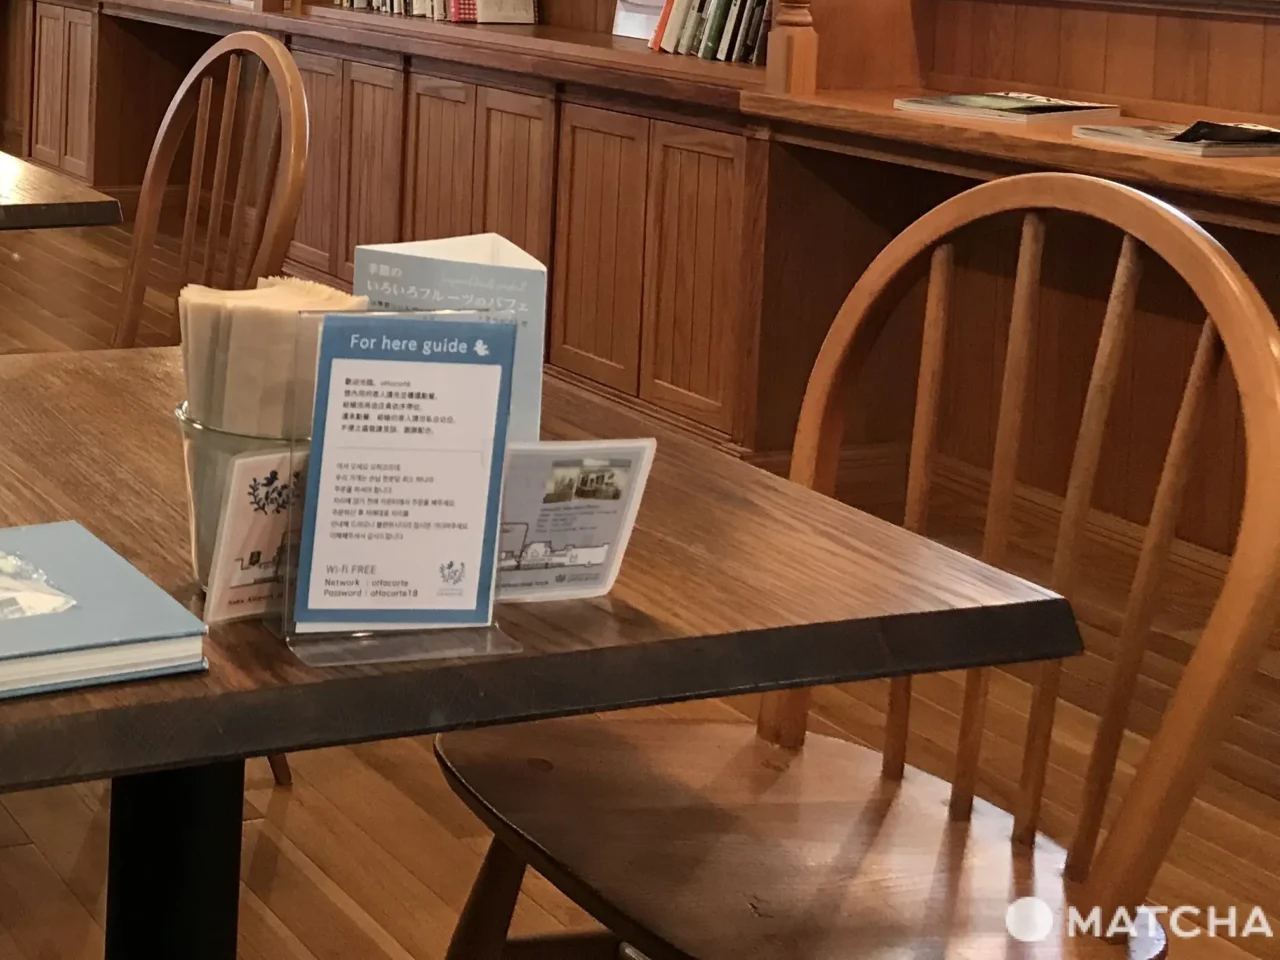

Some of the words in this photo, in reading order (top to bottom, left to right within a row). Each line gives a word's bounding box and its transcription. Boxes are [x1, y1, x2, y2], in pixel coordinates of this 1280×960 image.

[367, 280, 529, 313] いろいろフルーツのパフェ
[350, 334, 377, 350] For
[381, 335, 418, 351] here
[422, 338, 468, 355] guide
[351, 564, 377, 575] FREE
[324, 578, 360, 587] Network
[323, 588, 362, 597] Password
